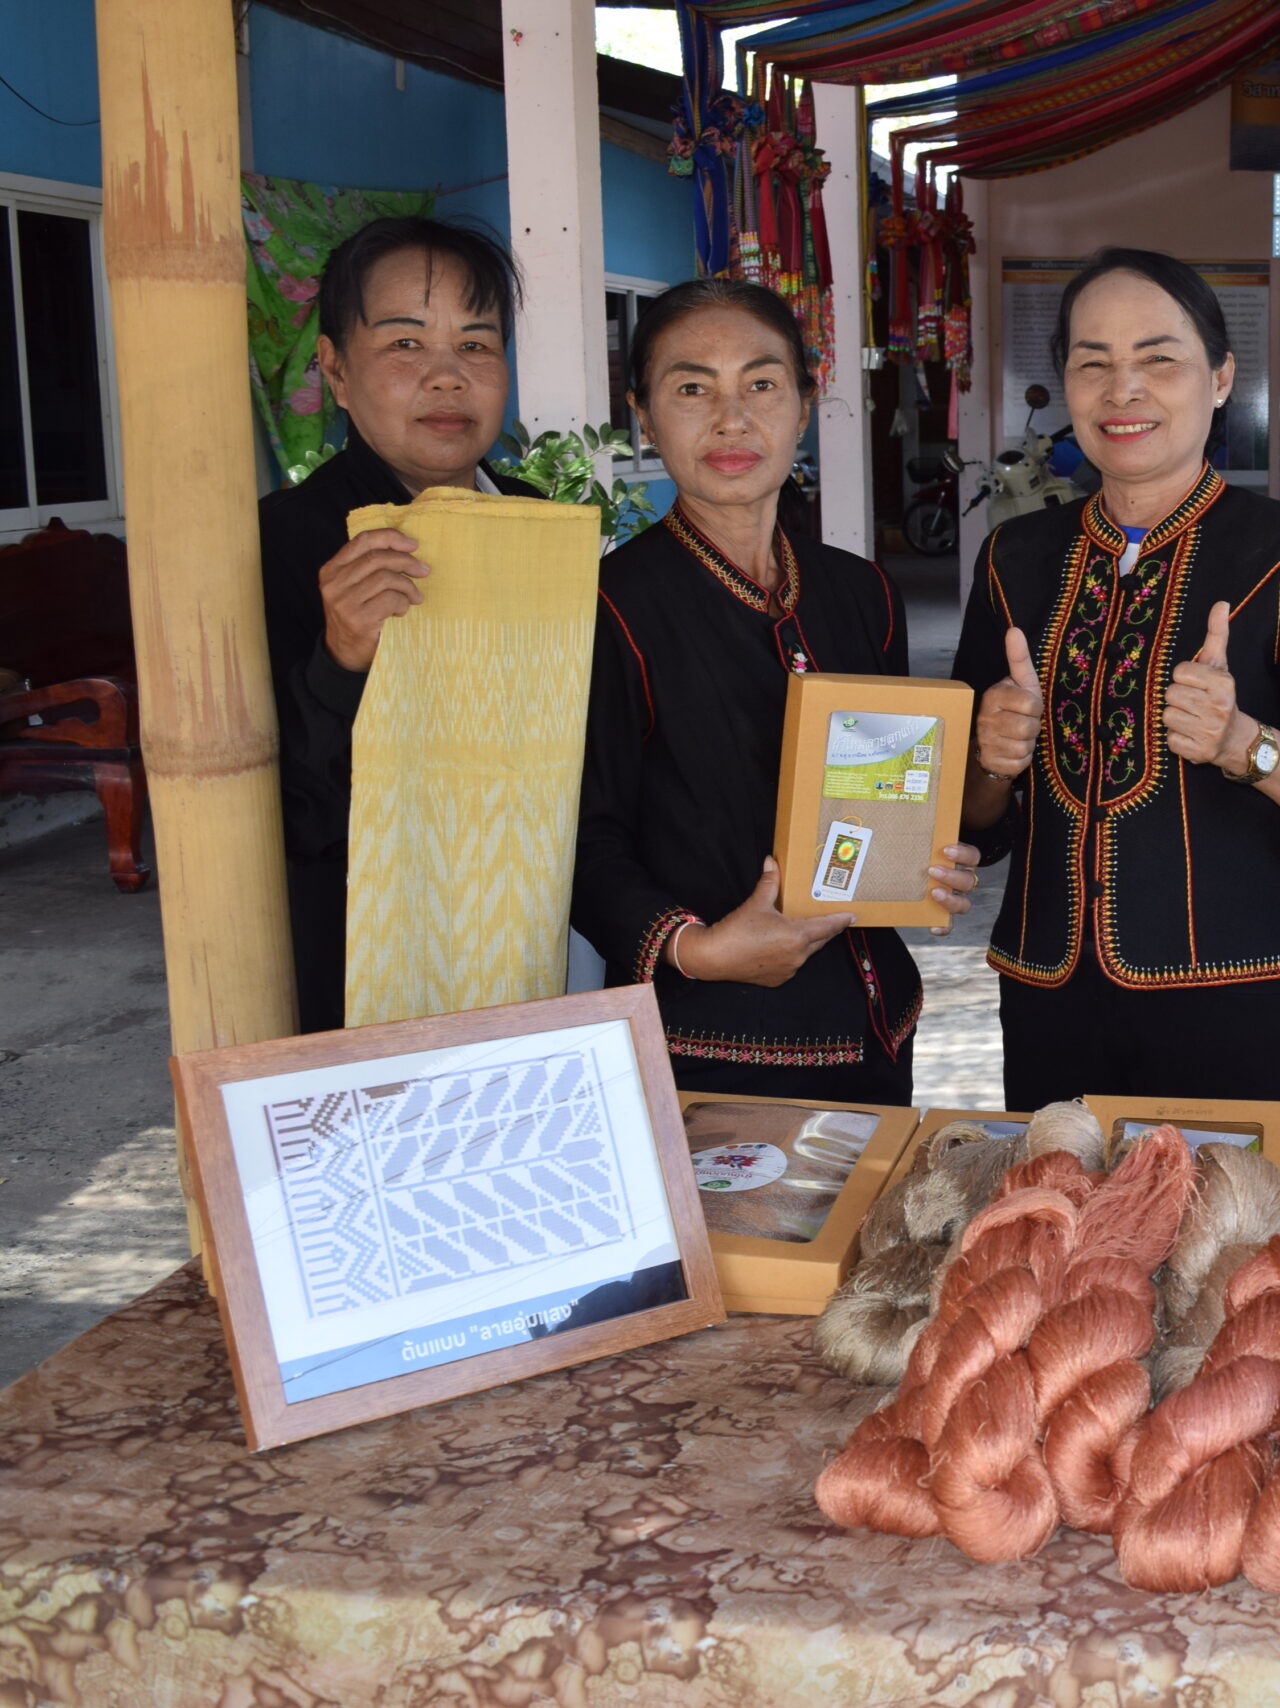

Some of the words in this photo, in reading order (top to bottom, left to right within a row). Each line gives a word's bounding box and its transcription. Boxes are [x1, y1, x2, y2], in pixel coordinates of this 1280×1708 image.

[401, 1332, 466, 1361] ต้นแบบ
[469, 1298, 580, 1341] "ลายอุ่มแสง"
